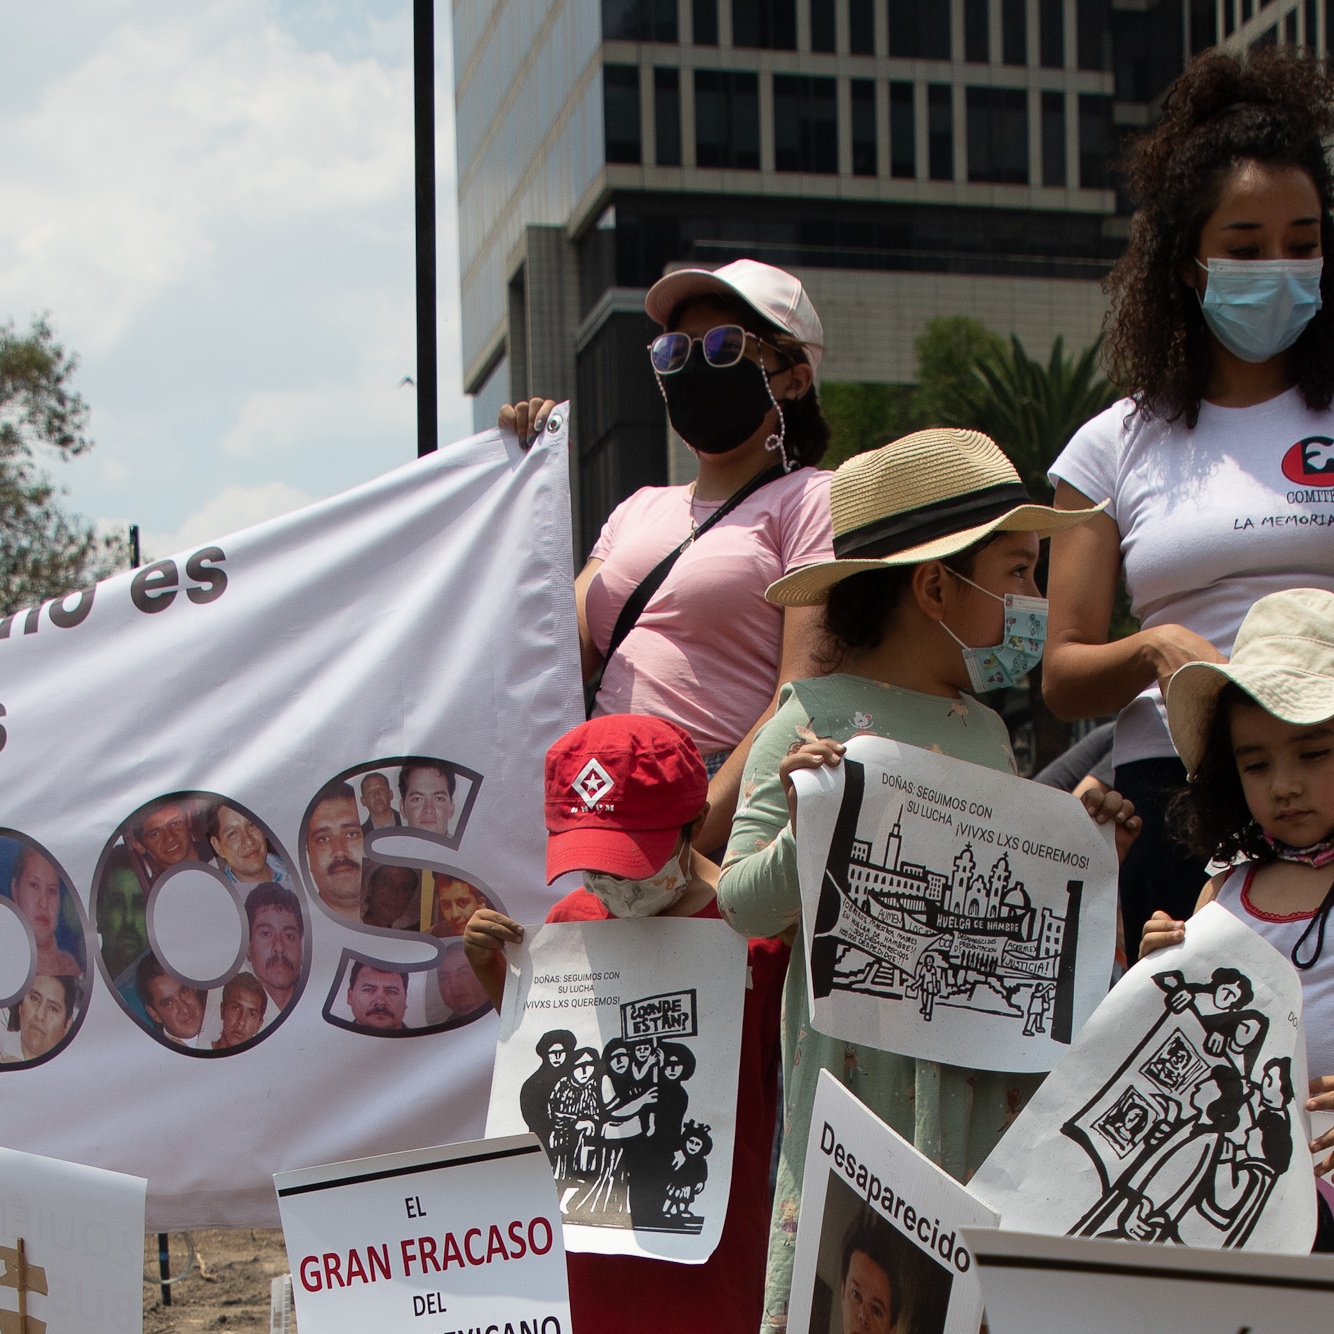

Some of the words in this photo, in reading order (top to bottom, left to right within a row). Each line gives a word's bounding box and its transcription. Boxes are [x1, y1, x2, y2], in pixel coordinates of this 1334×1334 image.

[1234, 518, 1254, 530] LA
[129, 546, 229, 615] es
[882, 772, 916, 795] DOÑAS:
[916, 786, 967, 812] SEGUIMOS
[969, 803, 993, 819] CON
[907, 801, 919, 815] SU
[921, 805, 953, 826] LUCHA
[955, 822, 995, 844] ¡VIVXS
[997, 832, 1020, 850] LXS
[1022, 840, 1090, 870] QUEREMOS!
[936, 913, 971, 930] HUELGA
[987, 921, 1019, 933] HAMBRE
[534, 974, 562, 984] DOÑAS:
[563, 973, 602, 983] SEGUIMOS
[604, 972, 620, 980] CON
[558, 985, 568, 993] SU
[570, 984, 594, 993] LUCHA
[523, 1001, 551, 1011] ¡VIVXS
[553, 1000, 569, 1008] LXS
[571, 996, 620, 1007] QUEREMOS!
[404, 1196, 427, 1219] EL
[819, 1120, 971, 1274] Desaparecido
[299, 1242, 391, 1293] GRAN
[401, 1216, 553, 1277] FRACASO
[412, 1292, 447, 1317] DEL
